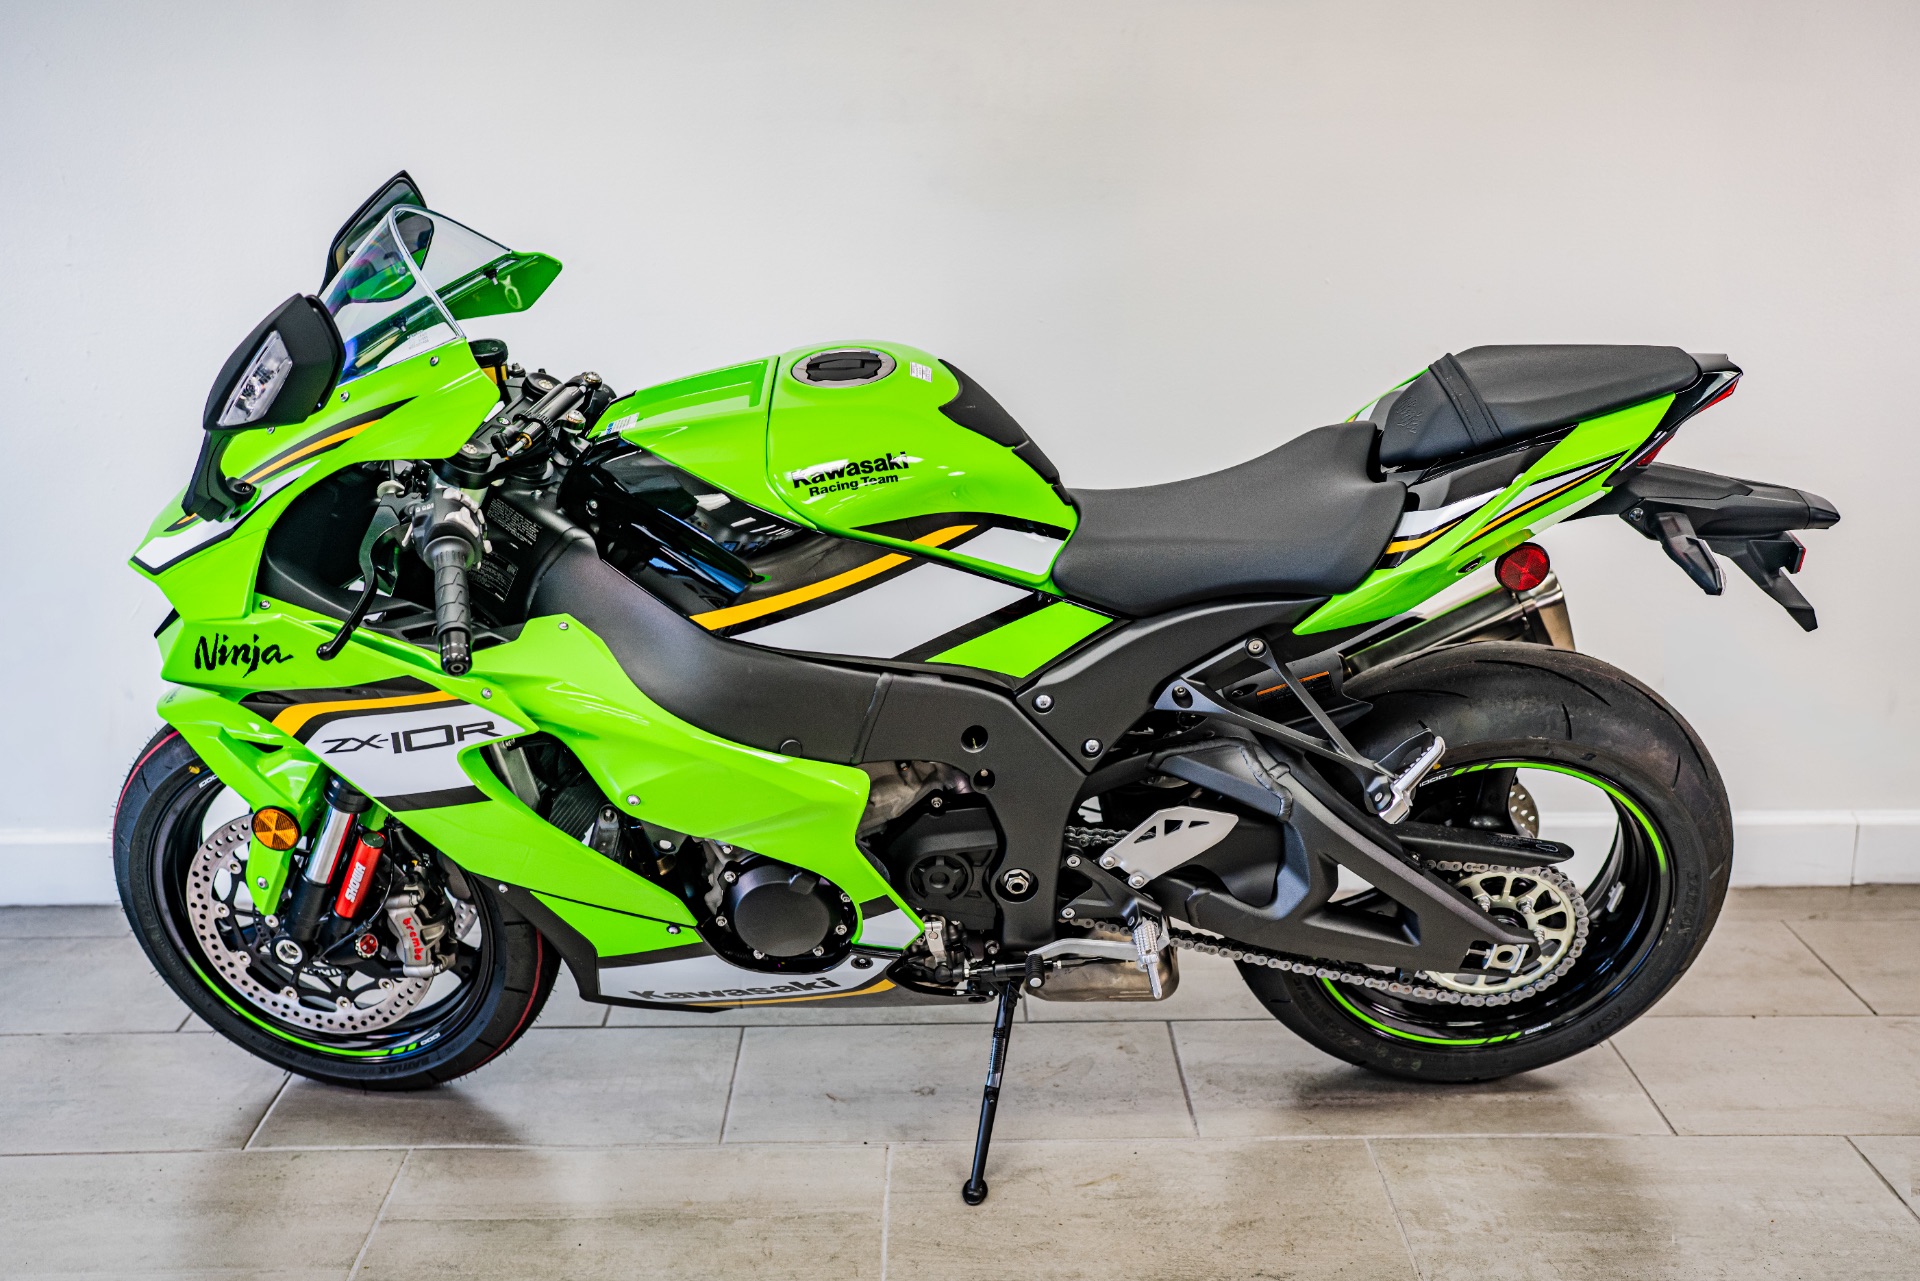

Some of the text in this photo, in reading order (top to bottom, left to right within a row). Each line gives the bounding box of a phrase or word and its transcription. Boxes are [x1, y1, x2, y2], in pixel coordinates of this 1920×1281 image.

[791, 451, 909, 488] Kawasaki
[809, 474, 899, 497] Racing Team
[194, 632, 294, 678] Ninja
[321, 721, 503, 754] ZX-10R
[344, 861, 366, 903] SHOWA
[402, 917, 424, 961] brembo
[628, 977, 841, 1000] Kawasaki
